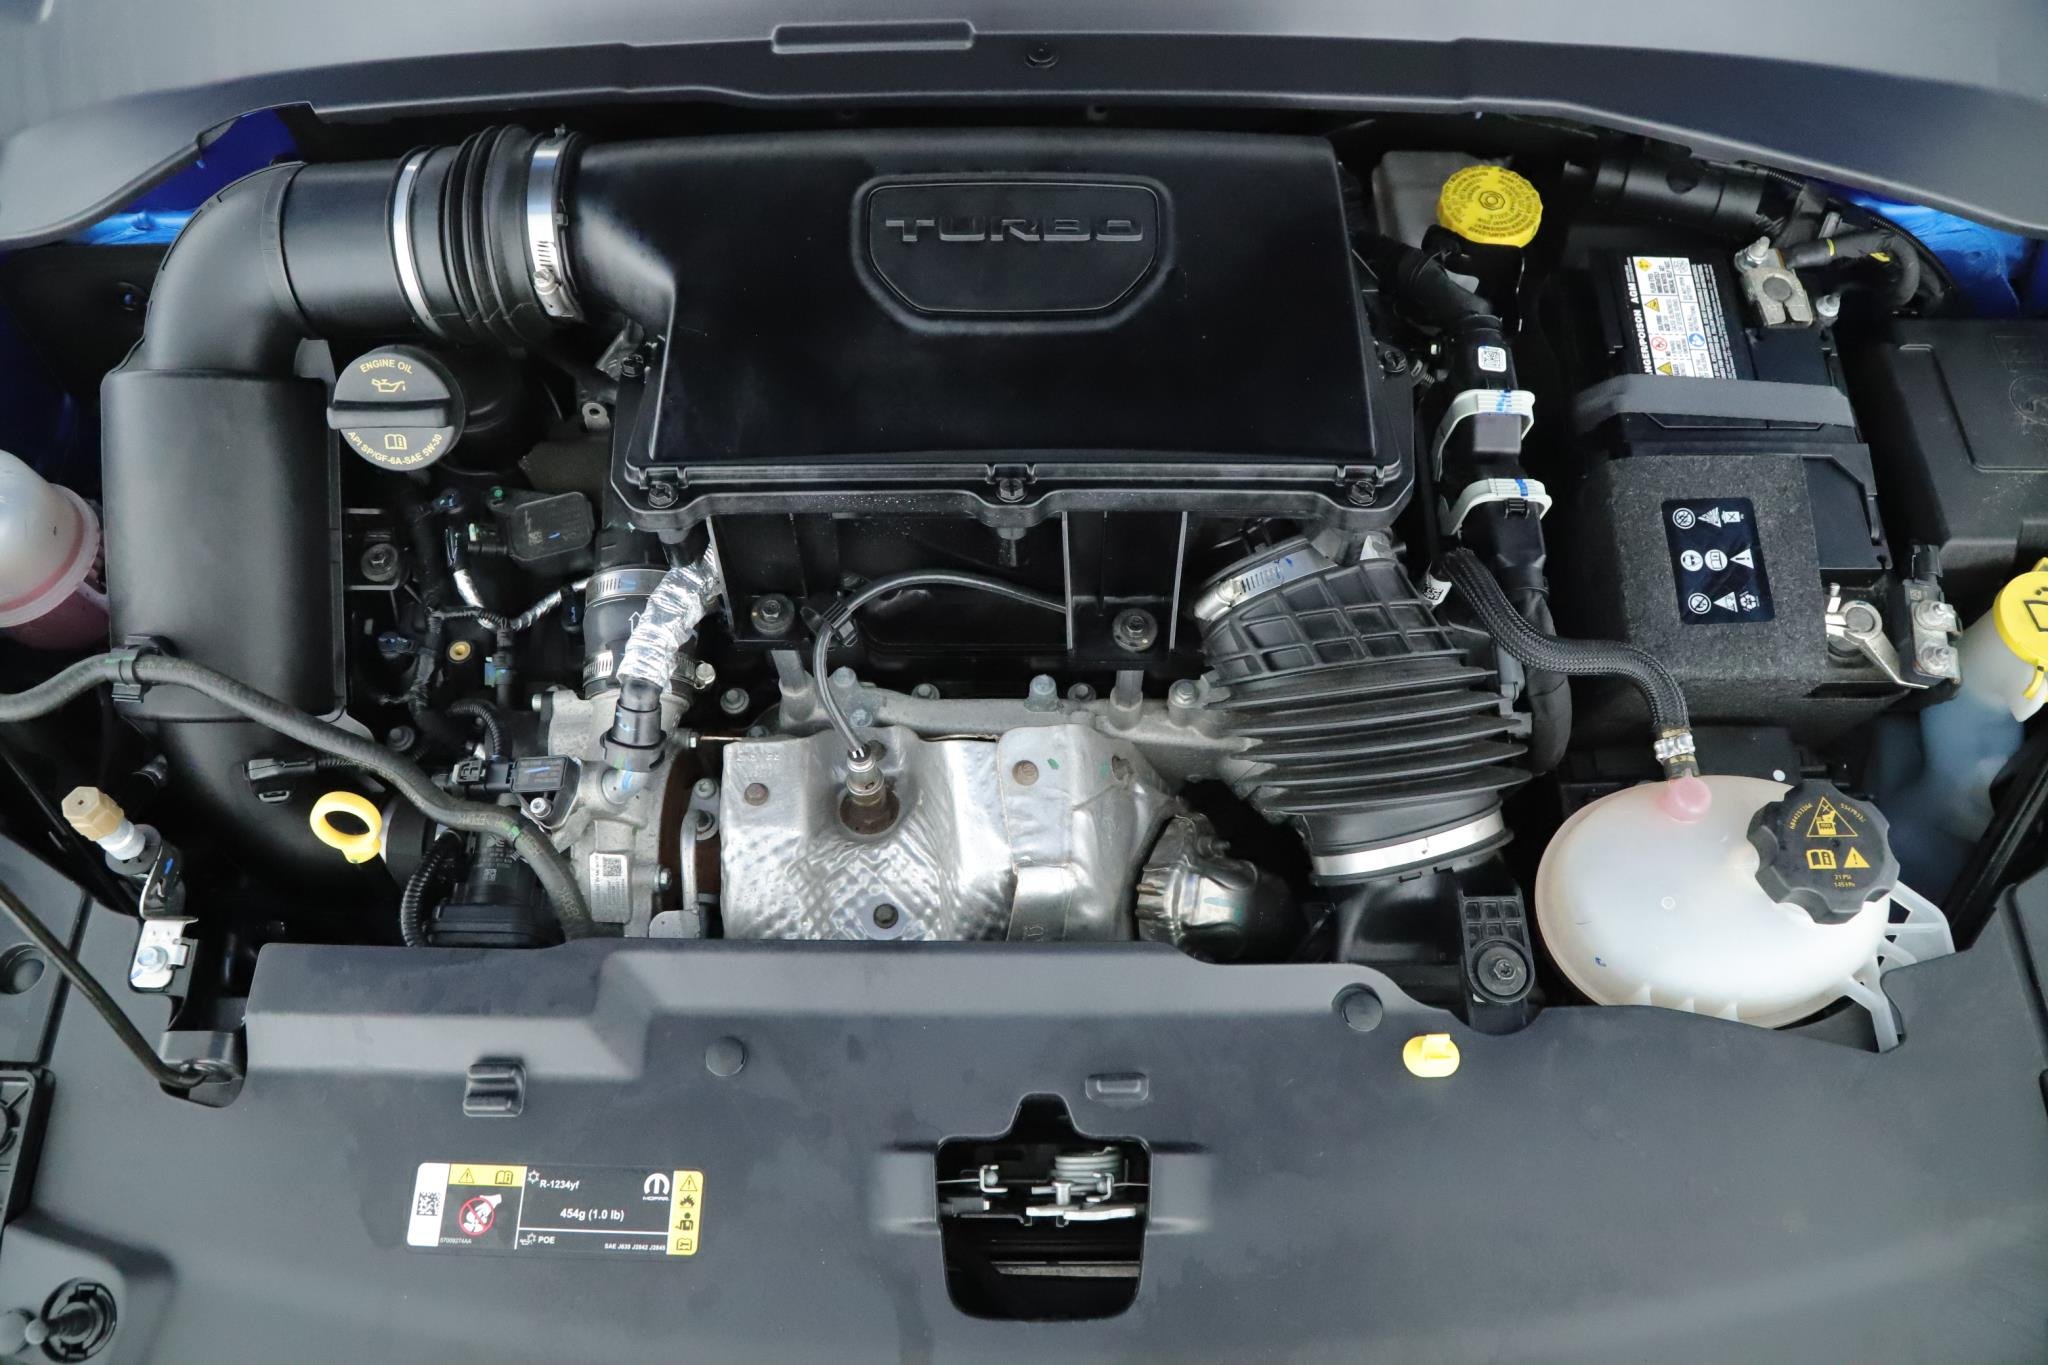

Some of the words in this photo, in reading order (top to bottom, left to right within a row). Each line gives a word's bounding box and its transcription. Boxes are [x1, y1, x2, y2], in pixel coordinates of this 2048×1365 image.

[885, 217, 1143, 241] TURBO
[1627, 282, 1639, 304] AGM
[1633, 309, 1653, 375] NGER/POISON
[360, 359, 396, 373] ENGINE
[397, 361, 414, 374] OIL
[347, 431, 362, 446] API
[422, 433, 443, 457] 5W-30
[539, 1179, 580, 1192] R-1234yf
[560, 1208, 586, 1221] 454g
[588, 1209, 608, 1221] (1.0
[610, 1209, 625, 1222] lb)
[538, 1236, 556, 1245] POE
